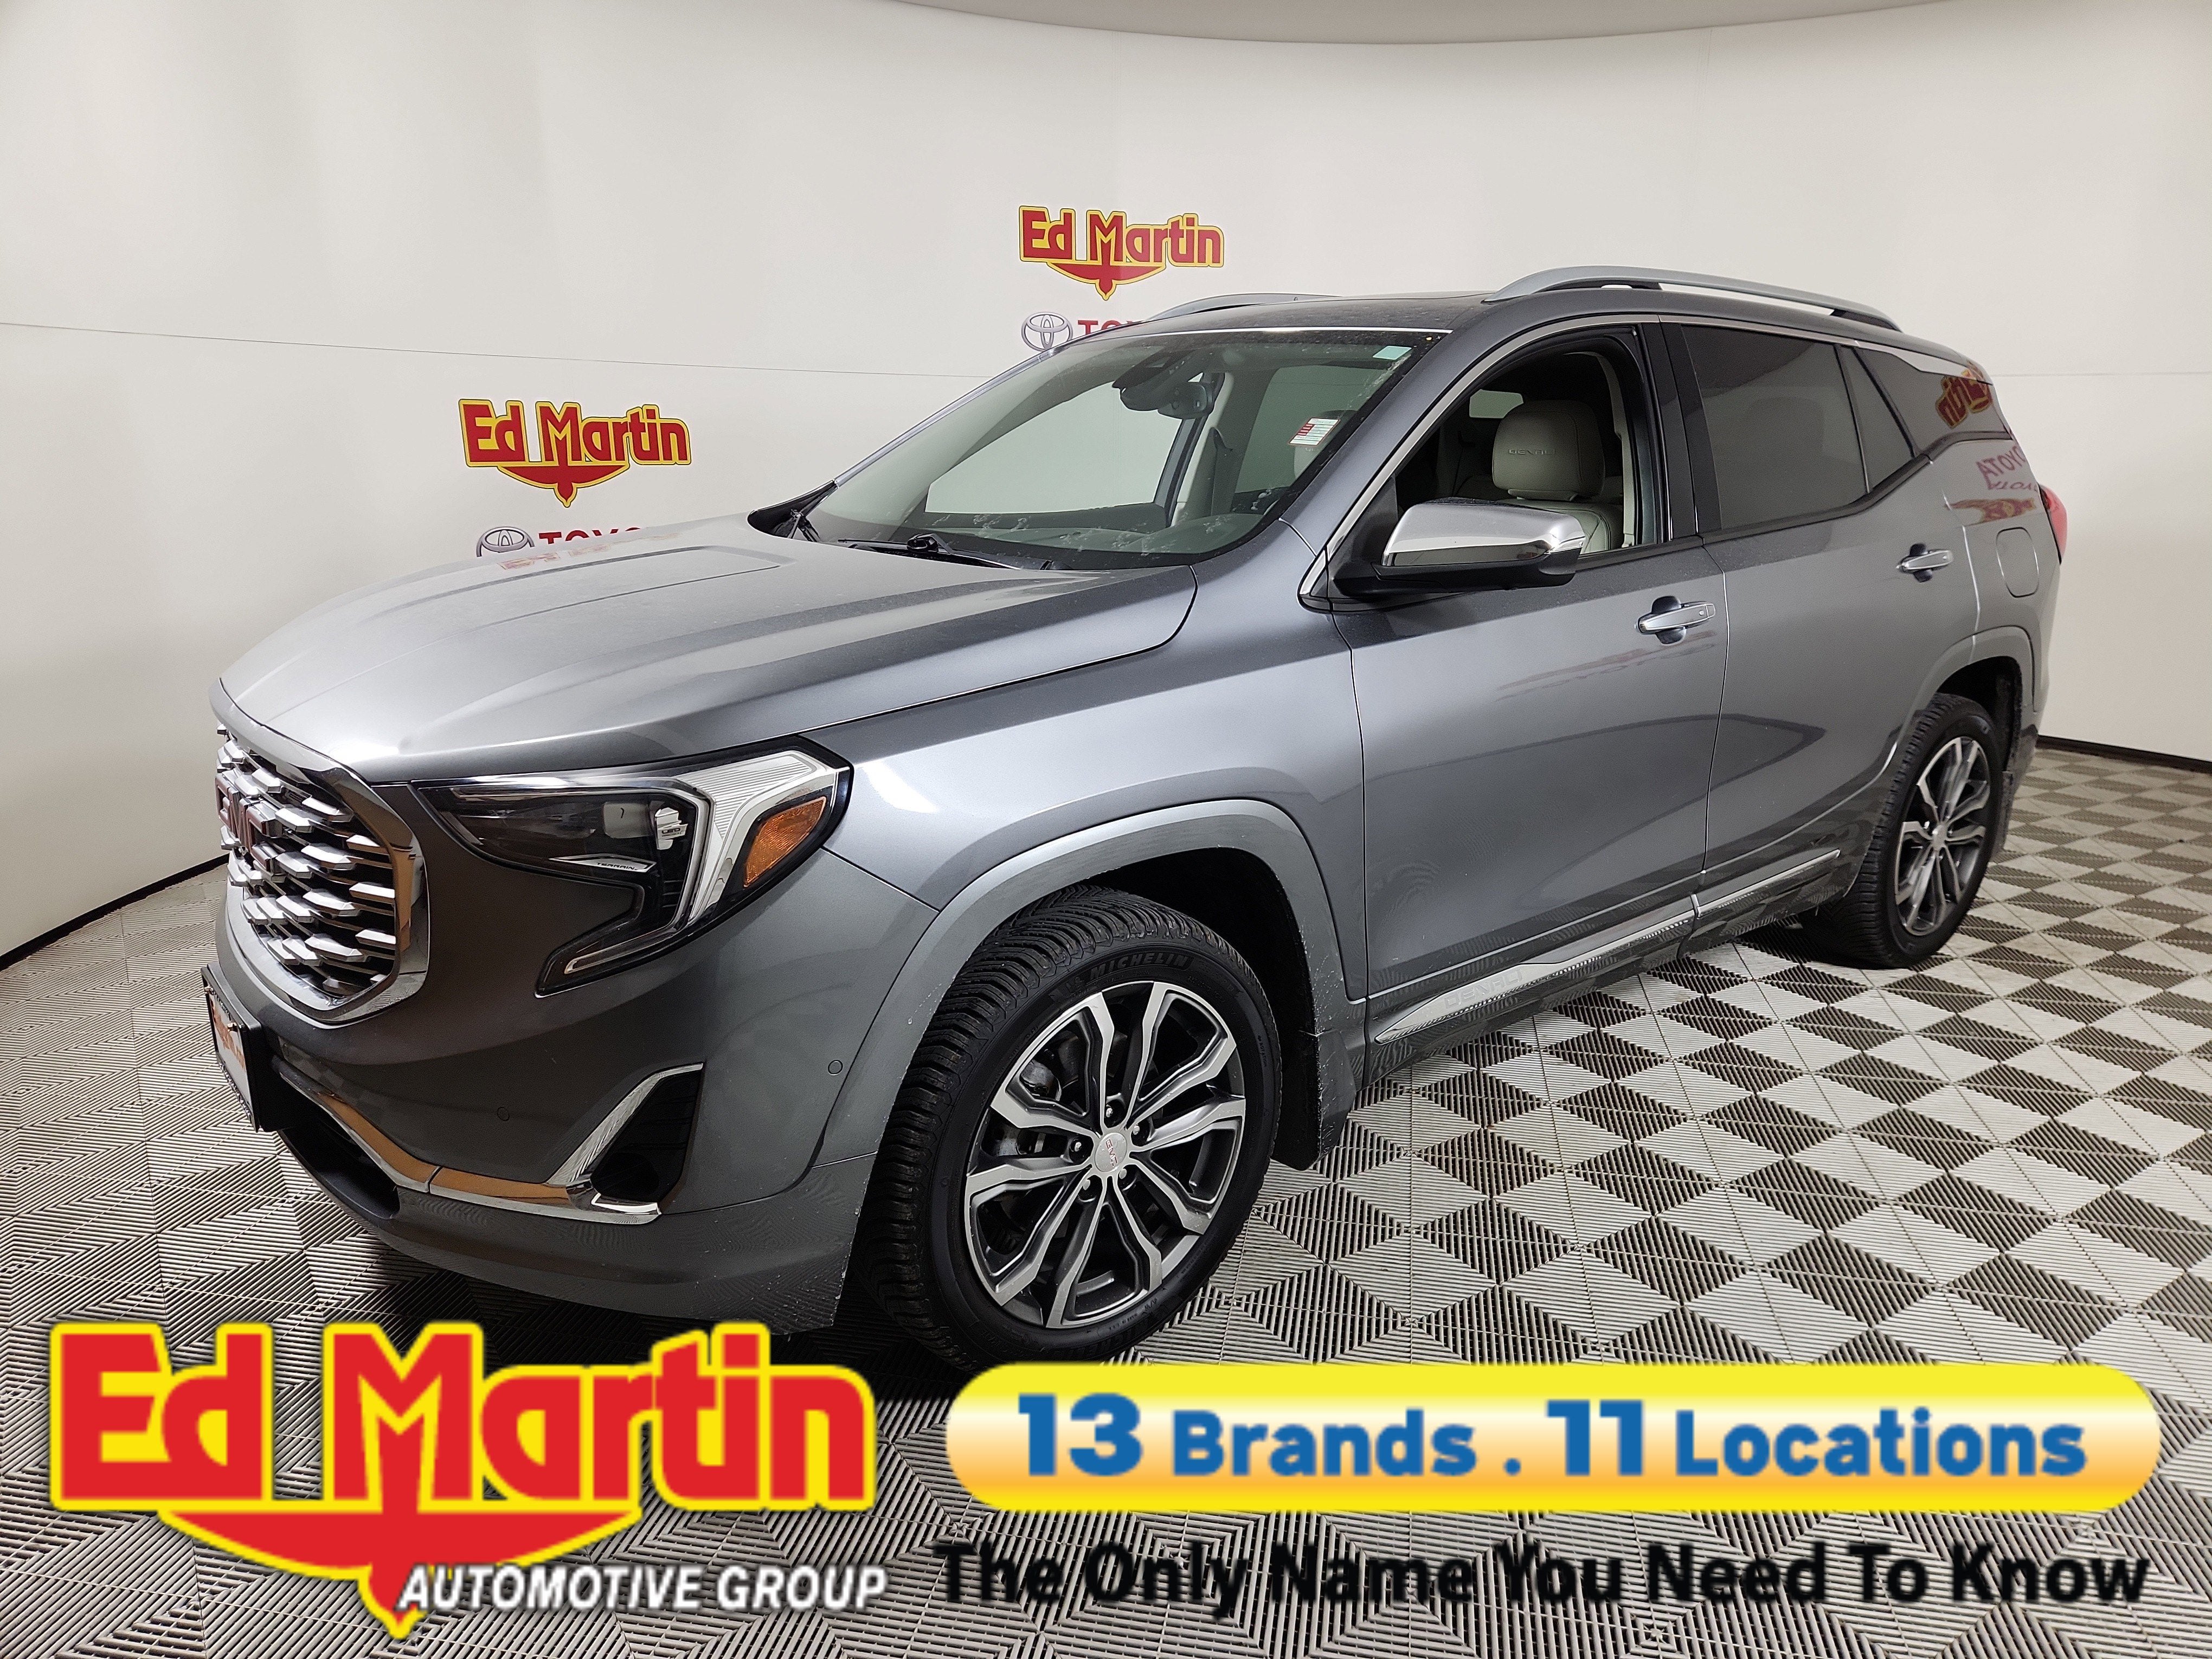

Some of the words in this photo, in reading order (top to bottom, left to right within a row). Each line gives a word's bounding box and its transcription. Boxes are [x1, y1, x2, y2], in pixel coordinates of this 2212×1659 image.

[1019, 206, 1076, 262] Ed
[1086, 210, 1224, 267] Martin
[459, 399, 526, 467] Ed
[536, 402, 691, 465] Martin
[597, 862, 635, 870] TERRAIN
[1090, 952, 1189, 979] MICHELIN
